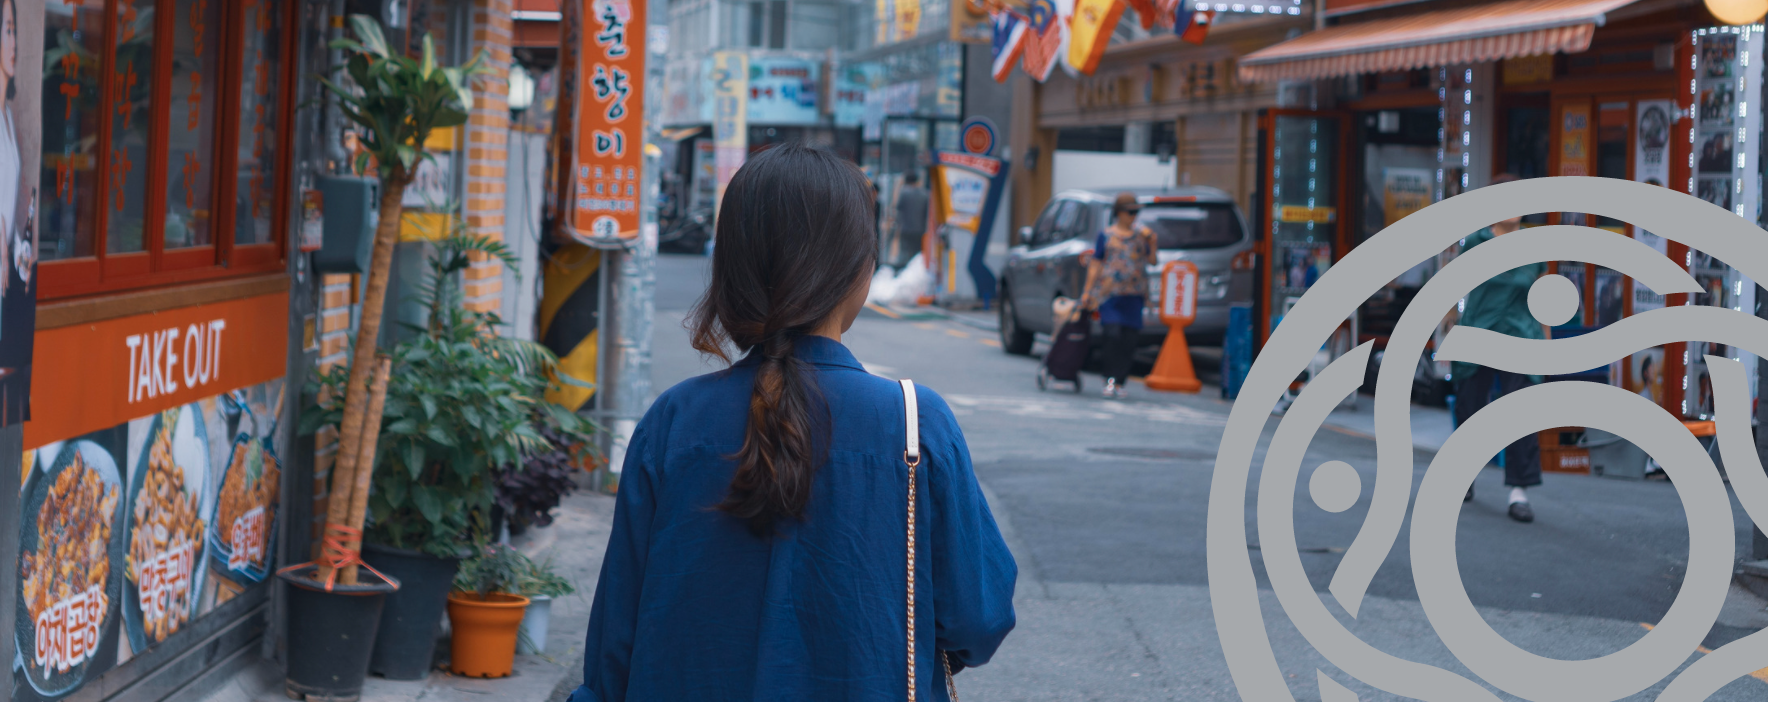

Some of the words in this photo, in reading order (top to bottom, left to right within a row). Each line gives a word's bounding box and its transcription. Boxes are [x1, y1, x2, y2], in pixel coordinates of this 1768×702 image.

[593, 4, 629, 156] 춘향이
[126, 327, 179, 404] TAKE
[183, 318, 226, 389] OUT
[140, 543, 193, 616] 막창구이
[36, 588, 100, 676] 야채곱창
